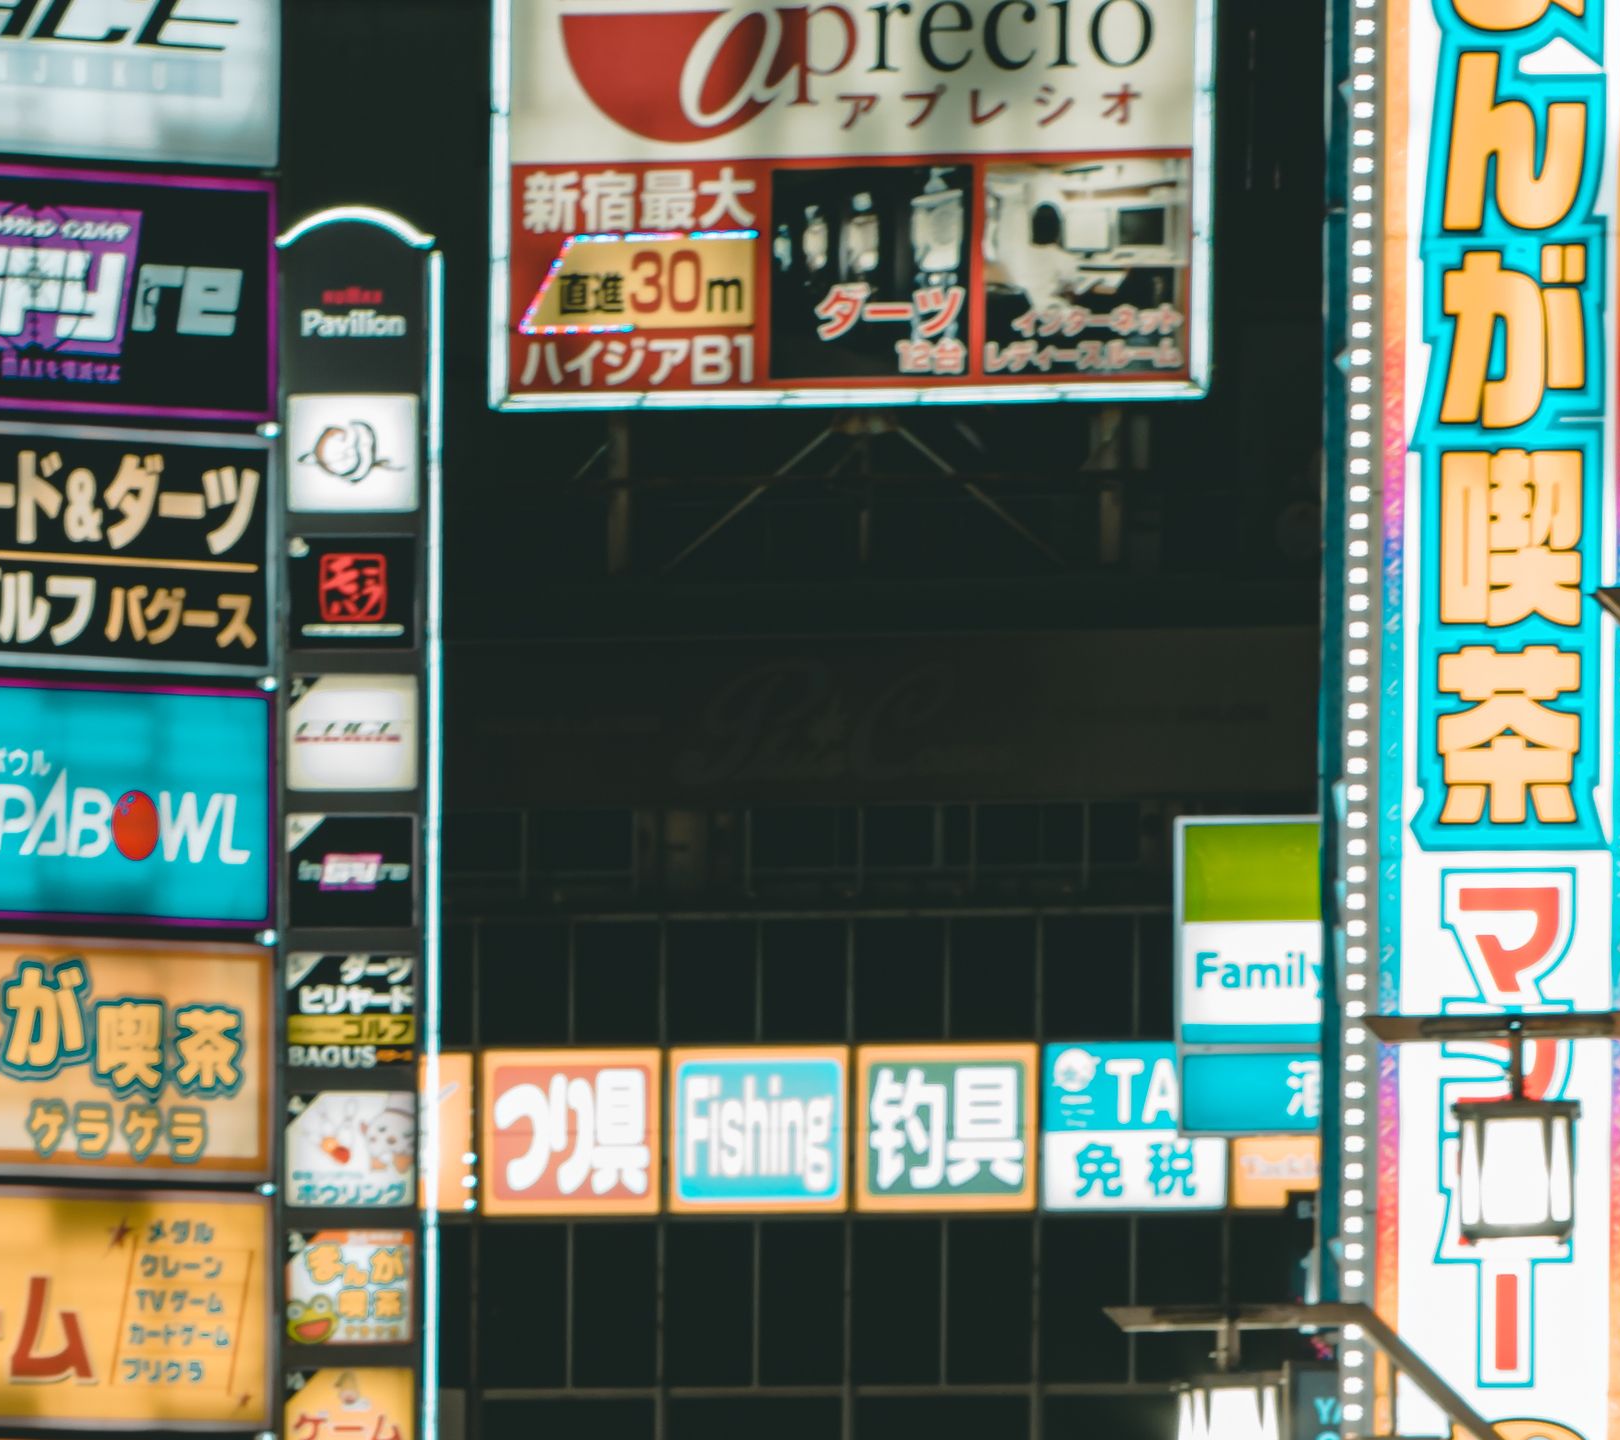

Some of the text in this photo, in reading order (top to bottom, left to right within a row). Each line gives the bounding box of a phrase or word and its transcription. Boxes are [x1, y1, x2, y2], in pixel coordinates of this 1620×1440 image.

[838, 83, 1142, 130] アプレシオ
[522, 168, 758, 234] 新宿最大
[557, 250, 746, 318] 直進30m
[300, 309, 407, 339] Pavilion
[816, 284, 966, 342] ダーツ
[520, 334, 756, 388] ハイジアB1
[896, 340, 966, 376] 12台
[339, 955, 414, 985] ダーツ
[298, 985, 415, 1014] ビリヤード
[287, 1043, 378, 1069] BAGUS
[493, 1068, 652, 1197] つり具
[683, 1073, 834, 1188] Fishing
[868, 1066, 1026, 1190] 釣具
[295, 1181, 407, 1205] ボウリング
[1073, 1140, 1198, 1200] 免税
[305, 1242, 407, 1287] まんが
